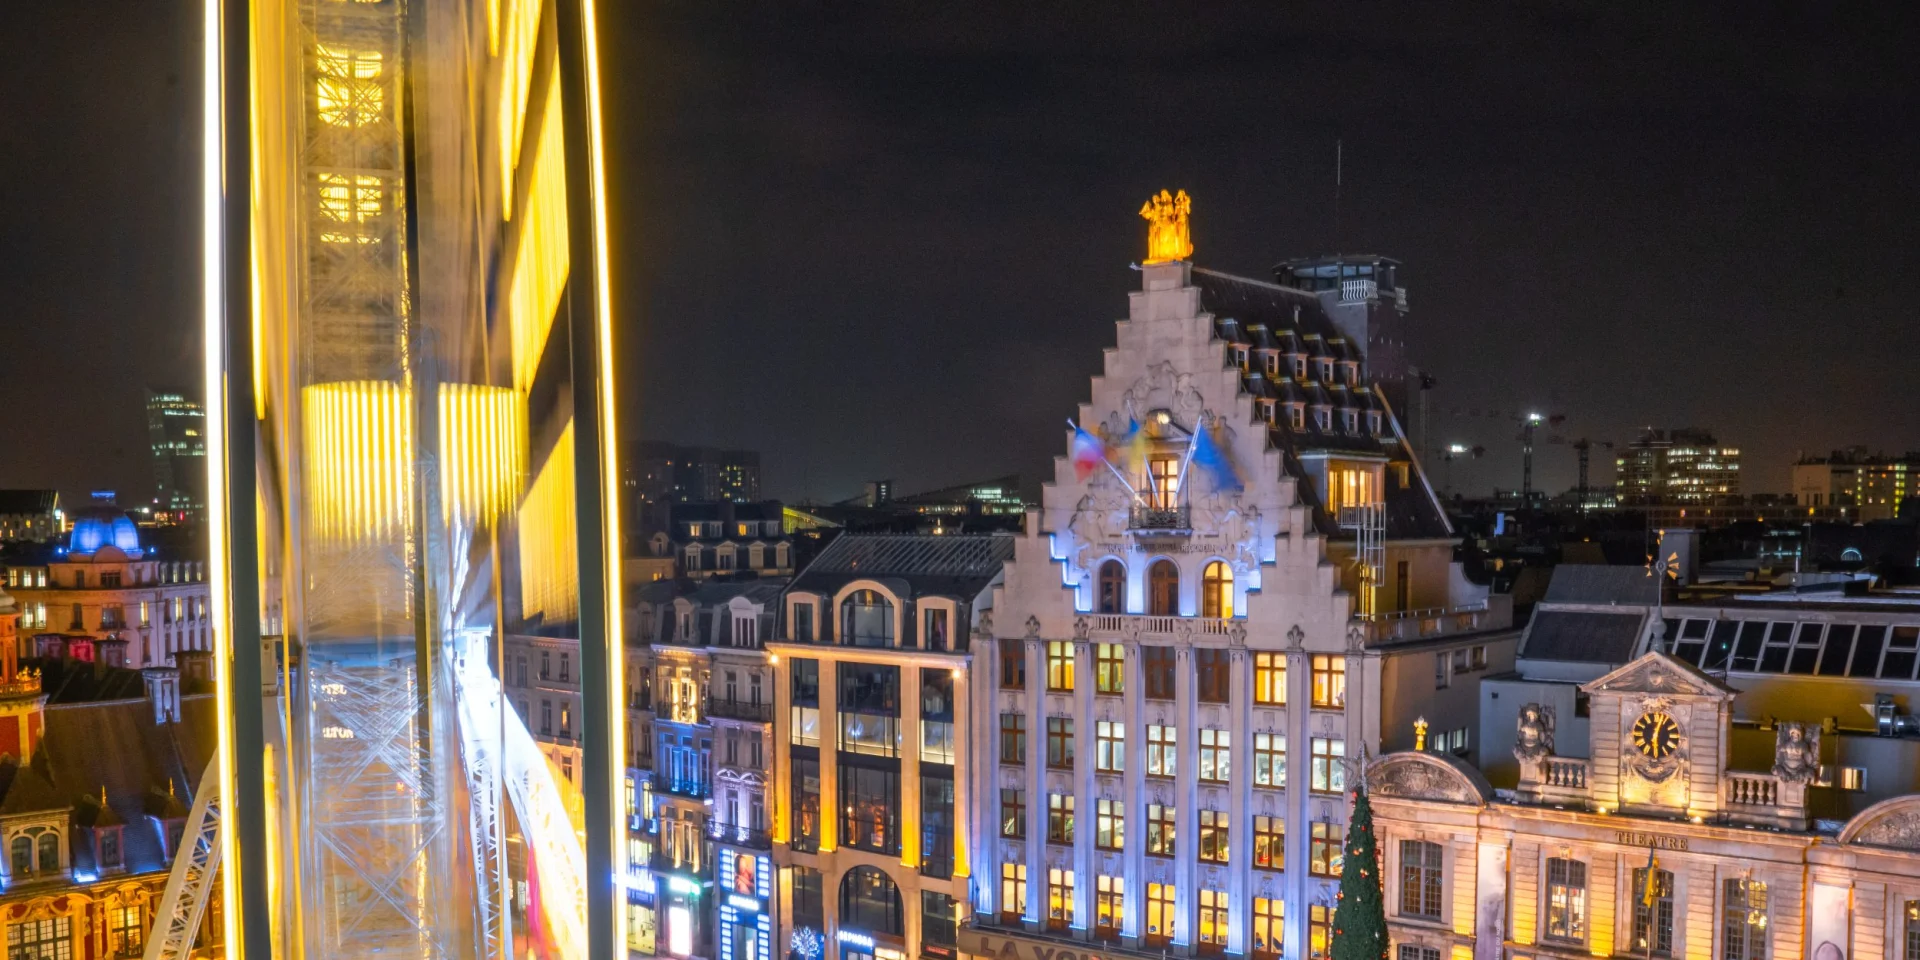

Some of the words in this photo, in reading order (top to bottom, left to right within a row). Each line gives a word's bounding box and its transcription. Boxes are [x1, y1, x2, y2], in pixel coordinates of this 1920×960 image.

[1615, 831, 1689, 851] THEATRE
[839, 930, 873, 948] SEPHORA
[980, 936, 1021, 960] LA
